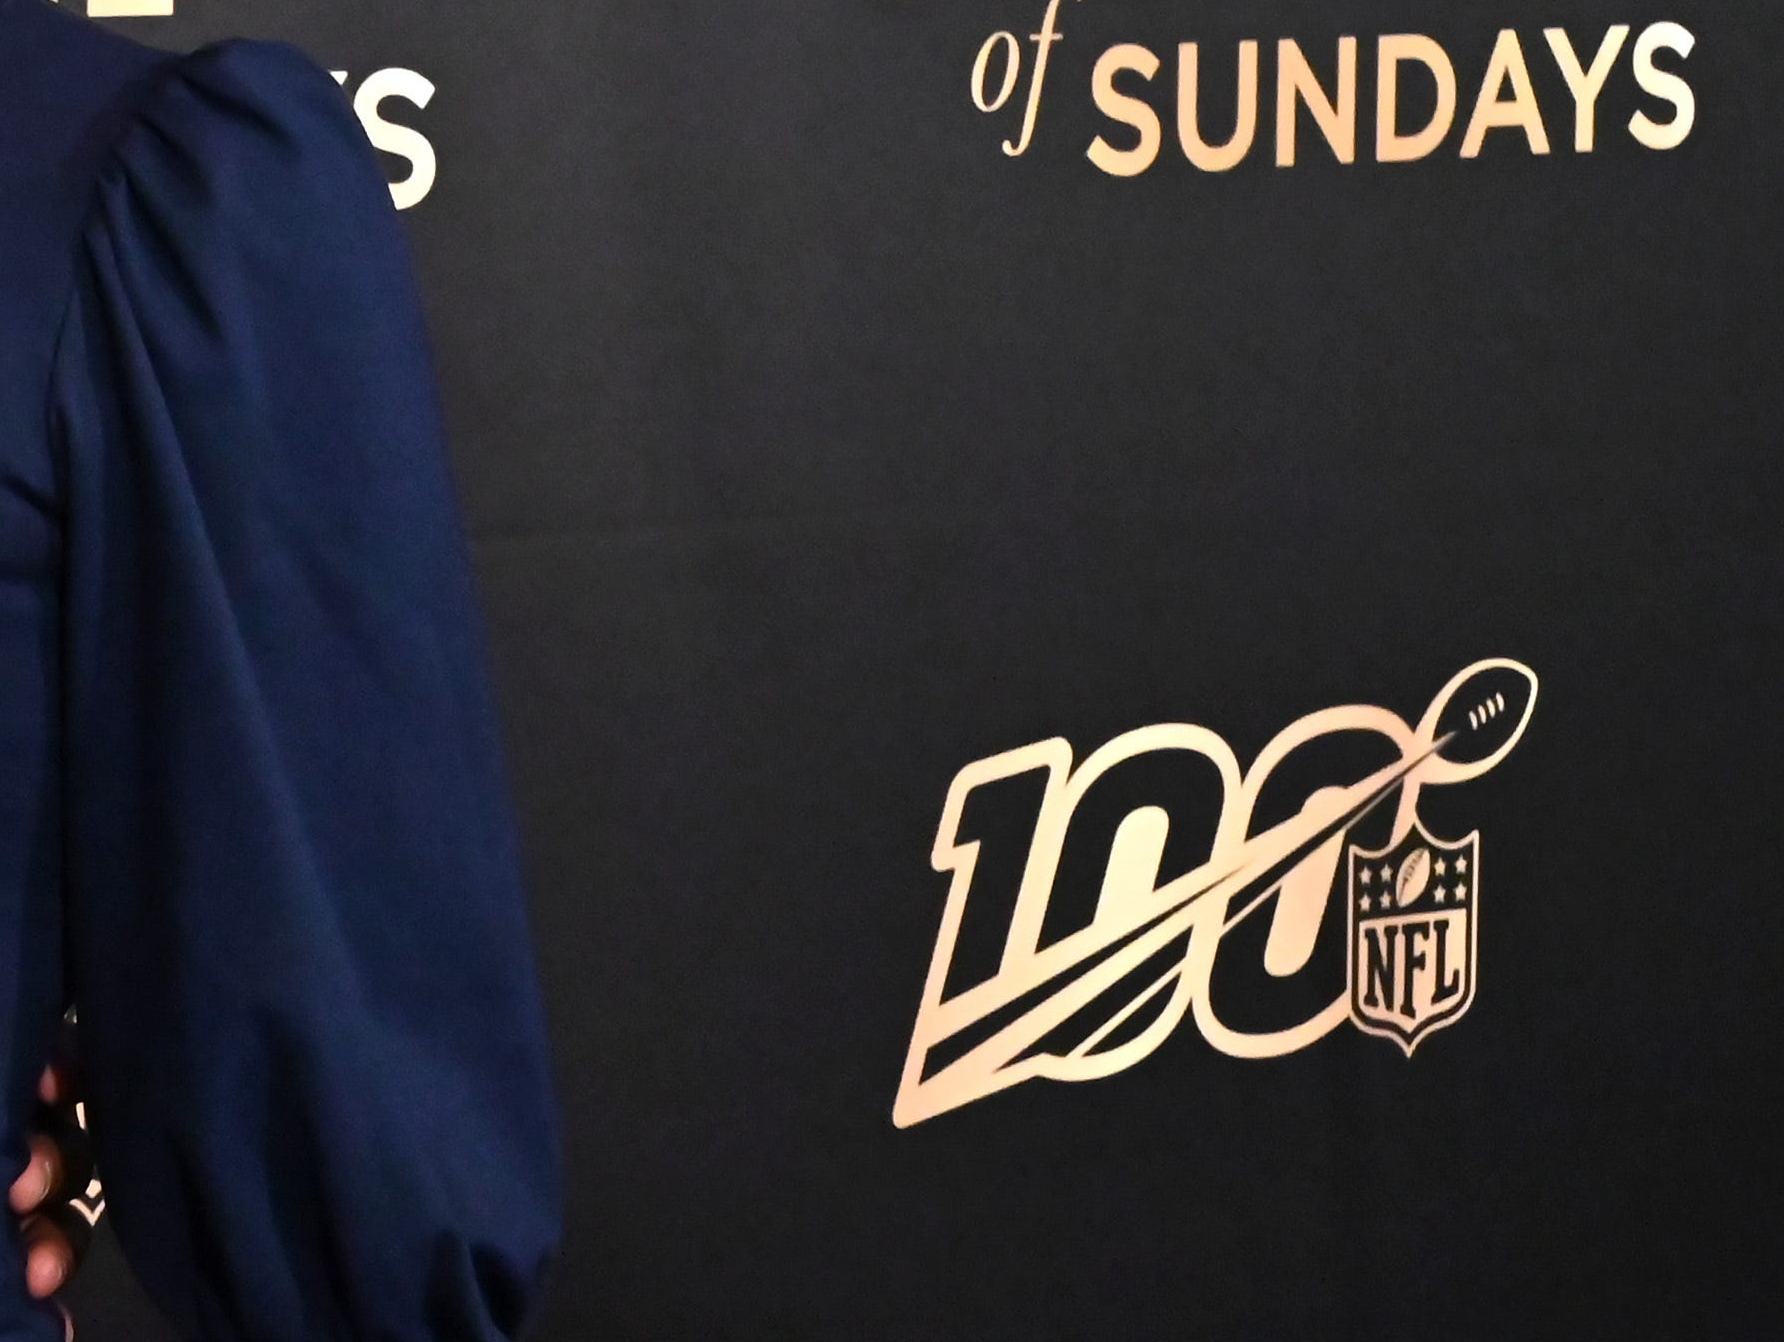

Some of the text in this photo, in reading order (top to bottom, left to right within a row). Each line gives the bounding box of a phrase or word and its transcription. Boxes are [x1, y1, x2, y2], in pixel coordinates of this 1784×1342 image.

[1086, 21, 1697, 178] SUNDAYS
[892, 703, 1417, 1130] 100
[1364, 919, 1461, 1018] NFL
